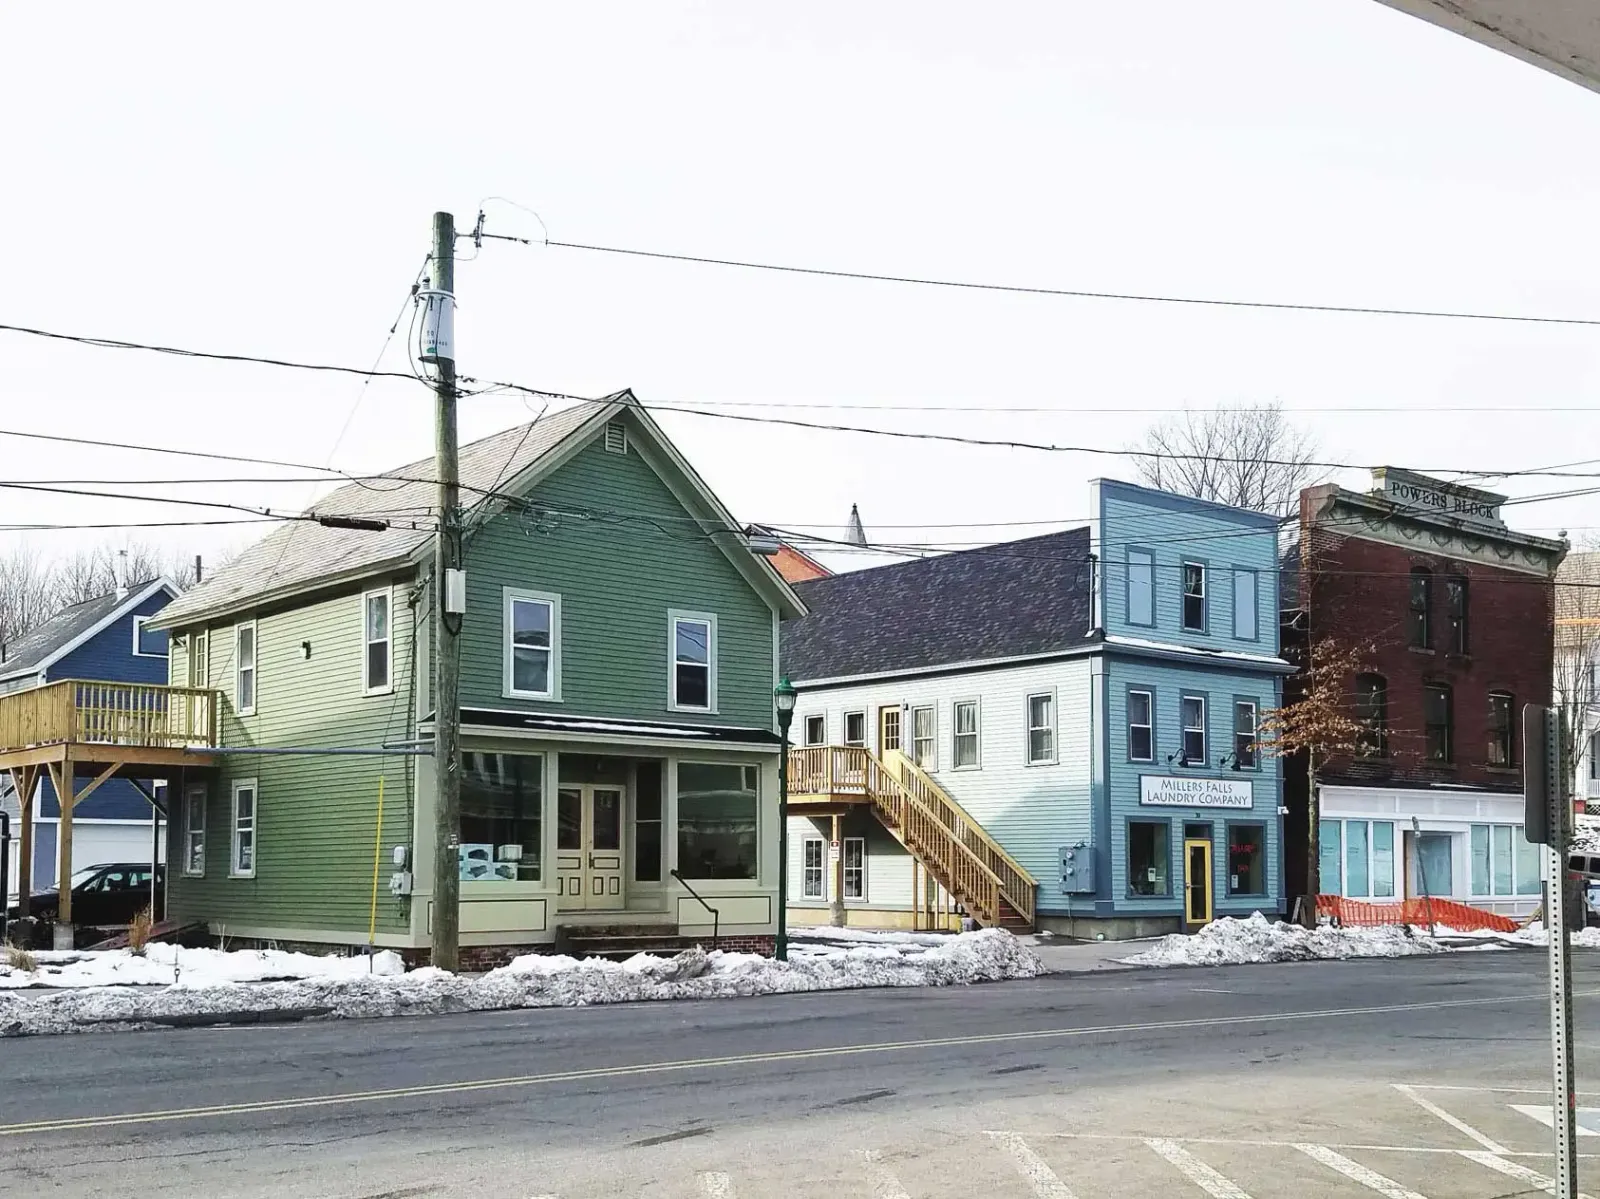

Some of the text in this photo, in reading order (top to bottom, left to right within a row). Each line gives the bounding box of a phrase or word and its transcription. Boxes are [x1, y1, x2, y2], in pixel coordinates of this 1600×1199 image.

[1392, 482, 1494, 519] POWERS BLOCK
[1161, 779, 1232, 794] MILLERS FALLS
[1147, 790, 1248, 806] LAUNDRY COMPANY
